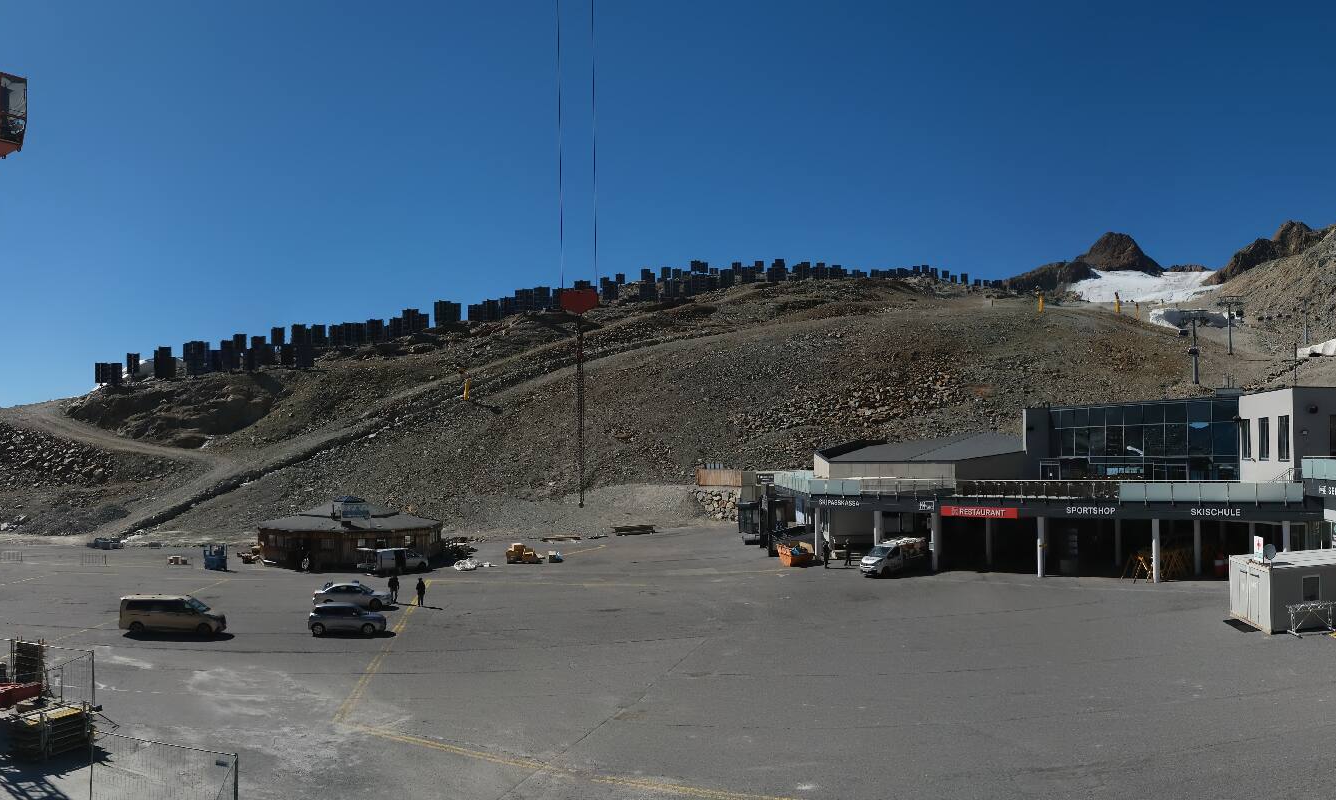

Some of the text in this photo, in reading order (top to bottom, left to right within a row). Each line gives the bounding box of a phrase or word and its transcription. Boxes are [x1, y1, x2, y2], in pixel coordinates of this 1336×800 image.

[959, 507, 1006, 517] RESTAURANT
[1066, 506, 1116, 516] SPORTSHOP
[1190, 507, 1241, 517] SKISCHULE
